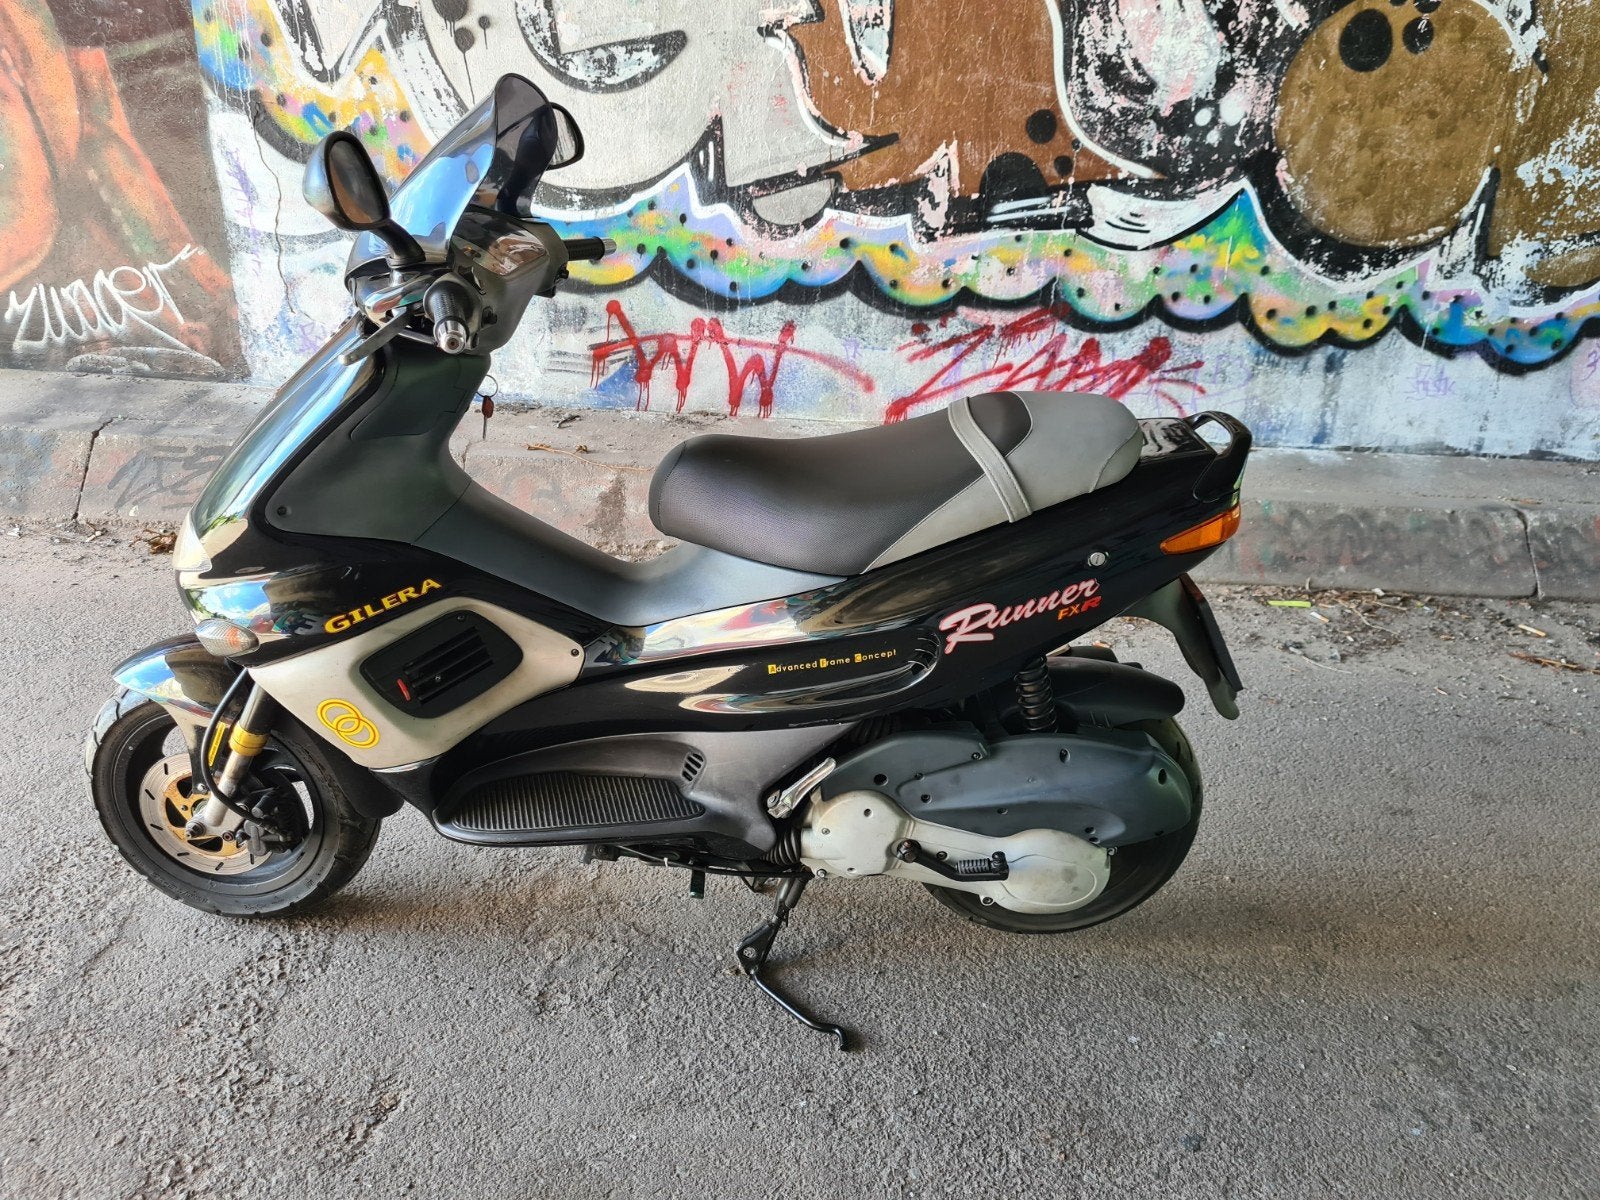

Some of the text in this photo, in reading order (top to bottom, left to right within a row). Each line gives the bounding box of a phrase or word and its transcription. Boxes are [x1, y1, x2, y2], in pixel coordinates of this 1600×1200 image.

[324, 578, 442, 634] GILERA
[939, 578, 1100, 655] Runner
[1057, 596, 1102, 621] FXR
[768, 649, 897, 675] Advanced Frame Concept
